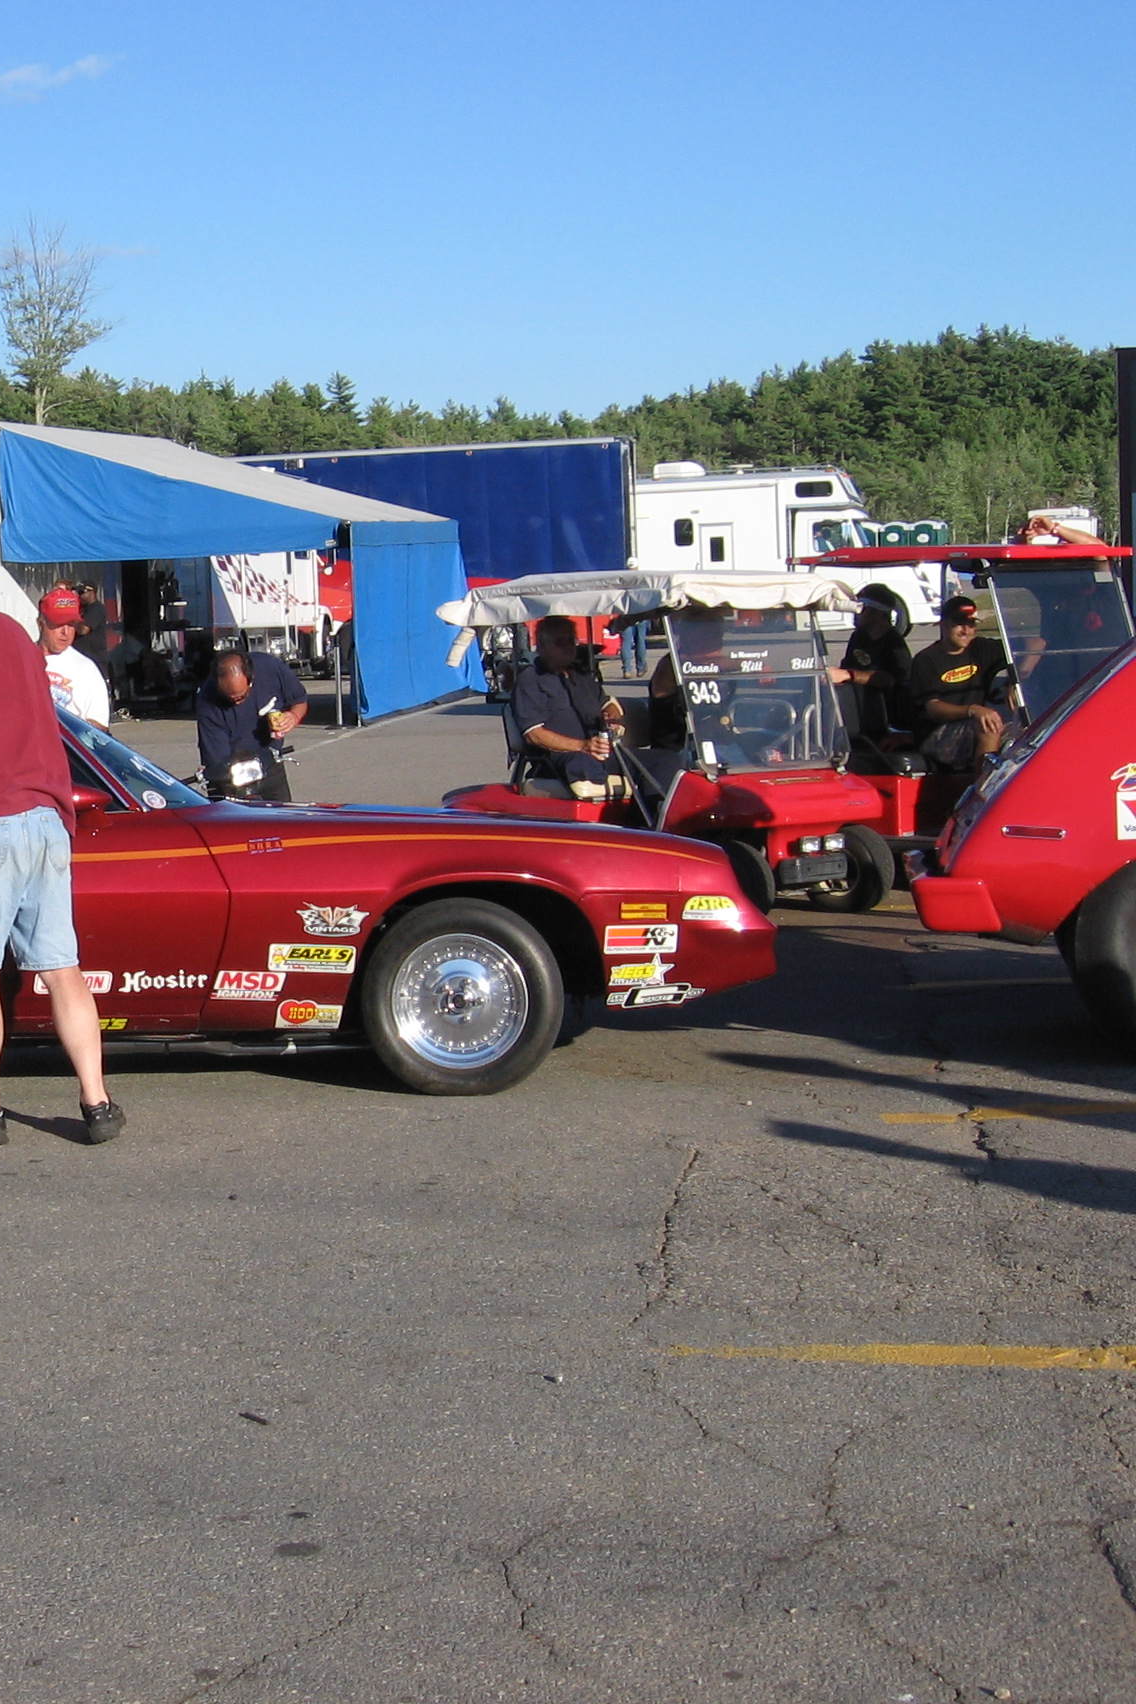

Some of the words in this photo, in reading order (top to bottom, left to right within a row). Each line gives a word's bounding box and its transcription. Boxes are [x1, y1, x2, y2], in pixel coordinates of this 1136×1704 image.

[791, 658, 814, 670] Bill
[689, 681, 720, 704] 343
[288, 947, 350, 960] EARL'S
[118, 969, 209, 992] Hoosier
[219, 972, 279, 990] MSD
[216, 990, 275, 999] IGNITION
